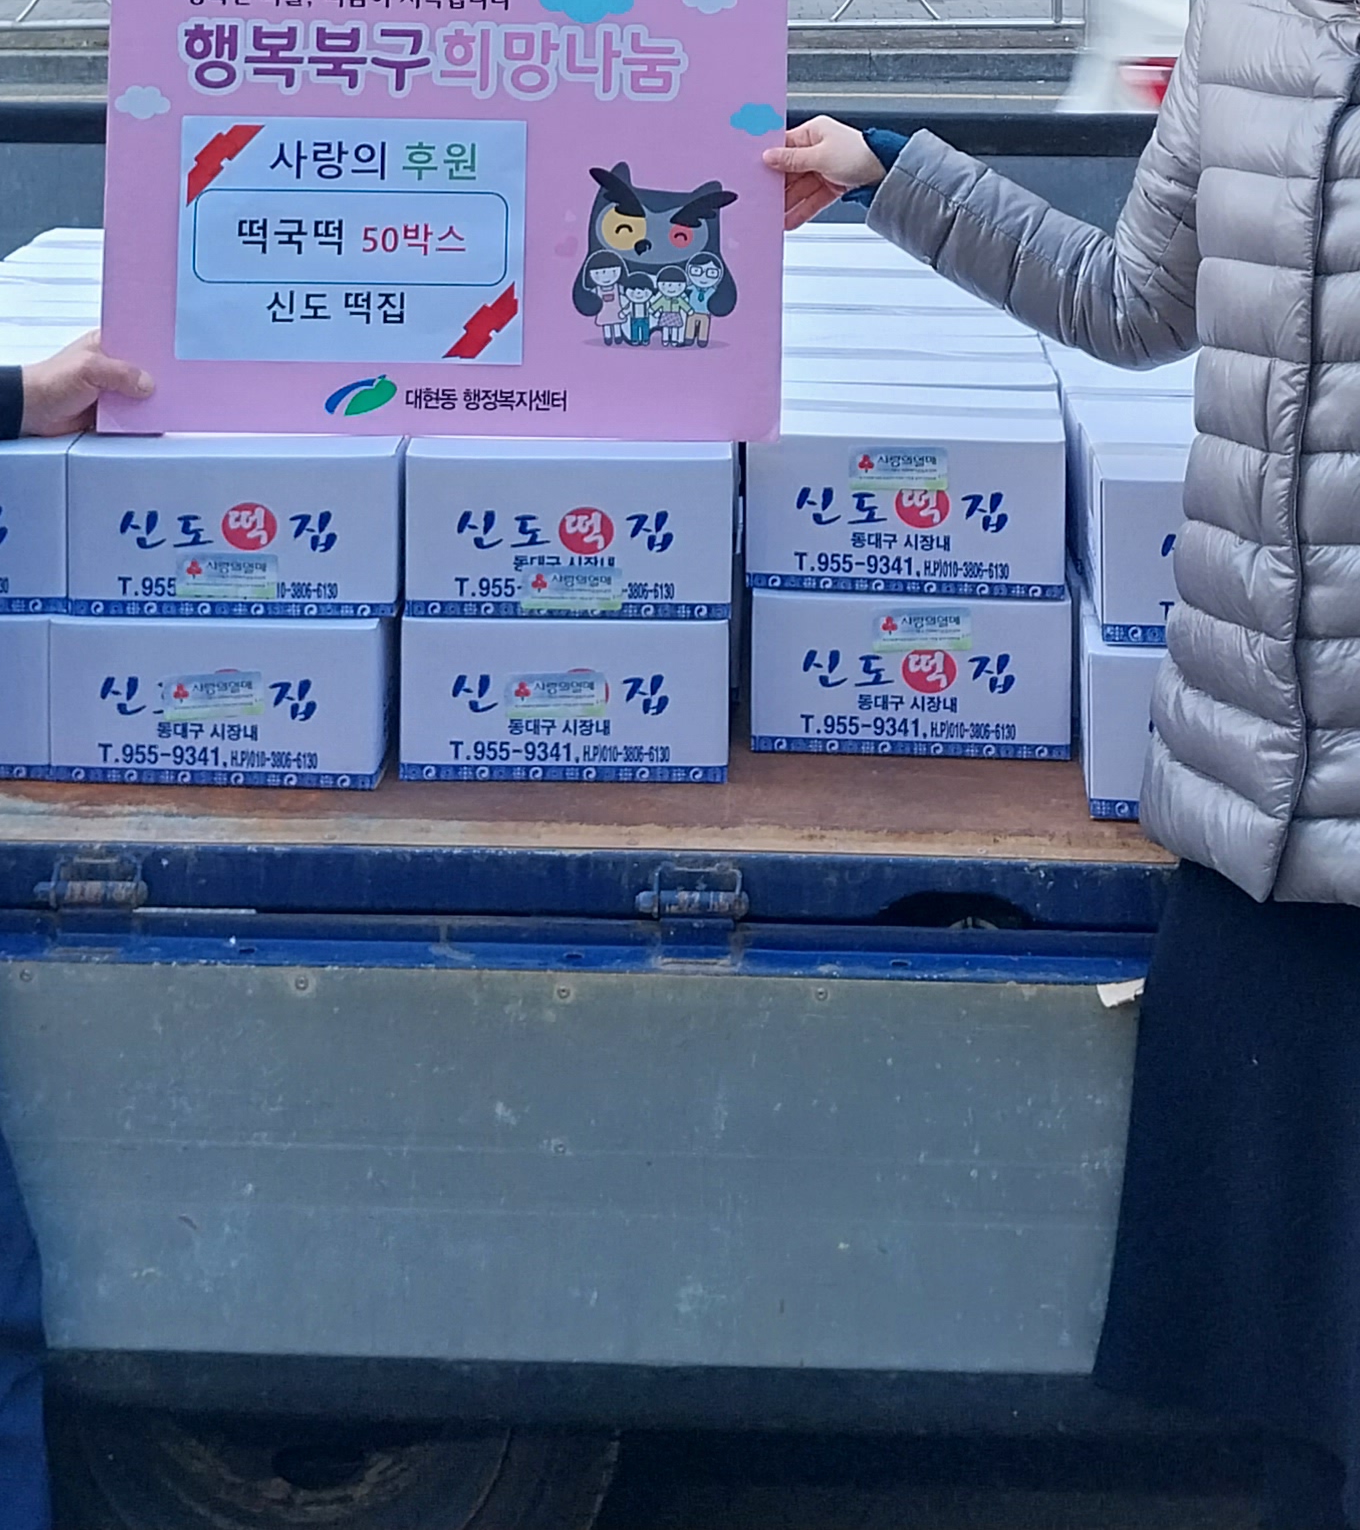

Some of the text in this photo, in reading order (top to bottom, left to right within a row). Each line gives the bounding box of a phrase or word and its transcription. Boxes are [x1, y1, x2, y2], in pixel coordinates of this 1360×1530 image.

[269, 140, 477, 181] 사랑의 후원
[237, 218, 467, 256] 떡국떡 50박스
[266, 290, 406, 325] 신도 떡집
[405, 387, 568, 412] 대현동 행정복지센터
[850, 532, 951, 552] 동대구 시장내
[857, 694, 958, 713] 동대구 시장내
[156, 722, 259, 741] 동대구 시장내
[507, 719, 611, 736] 동대구 시장내
